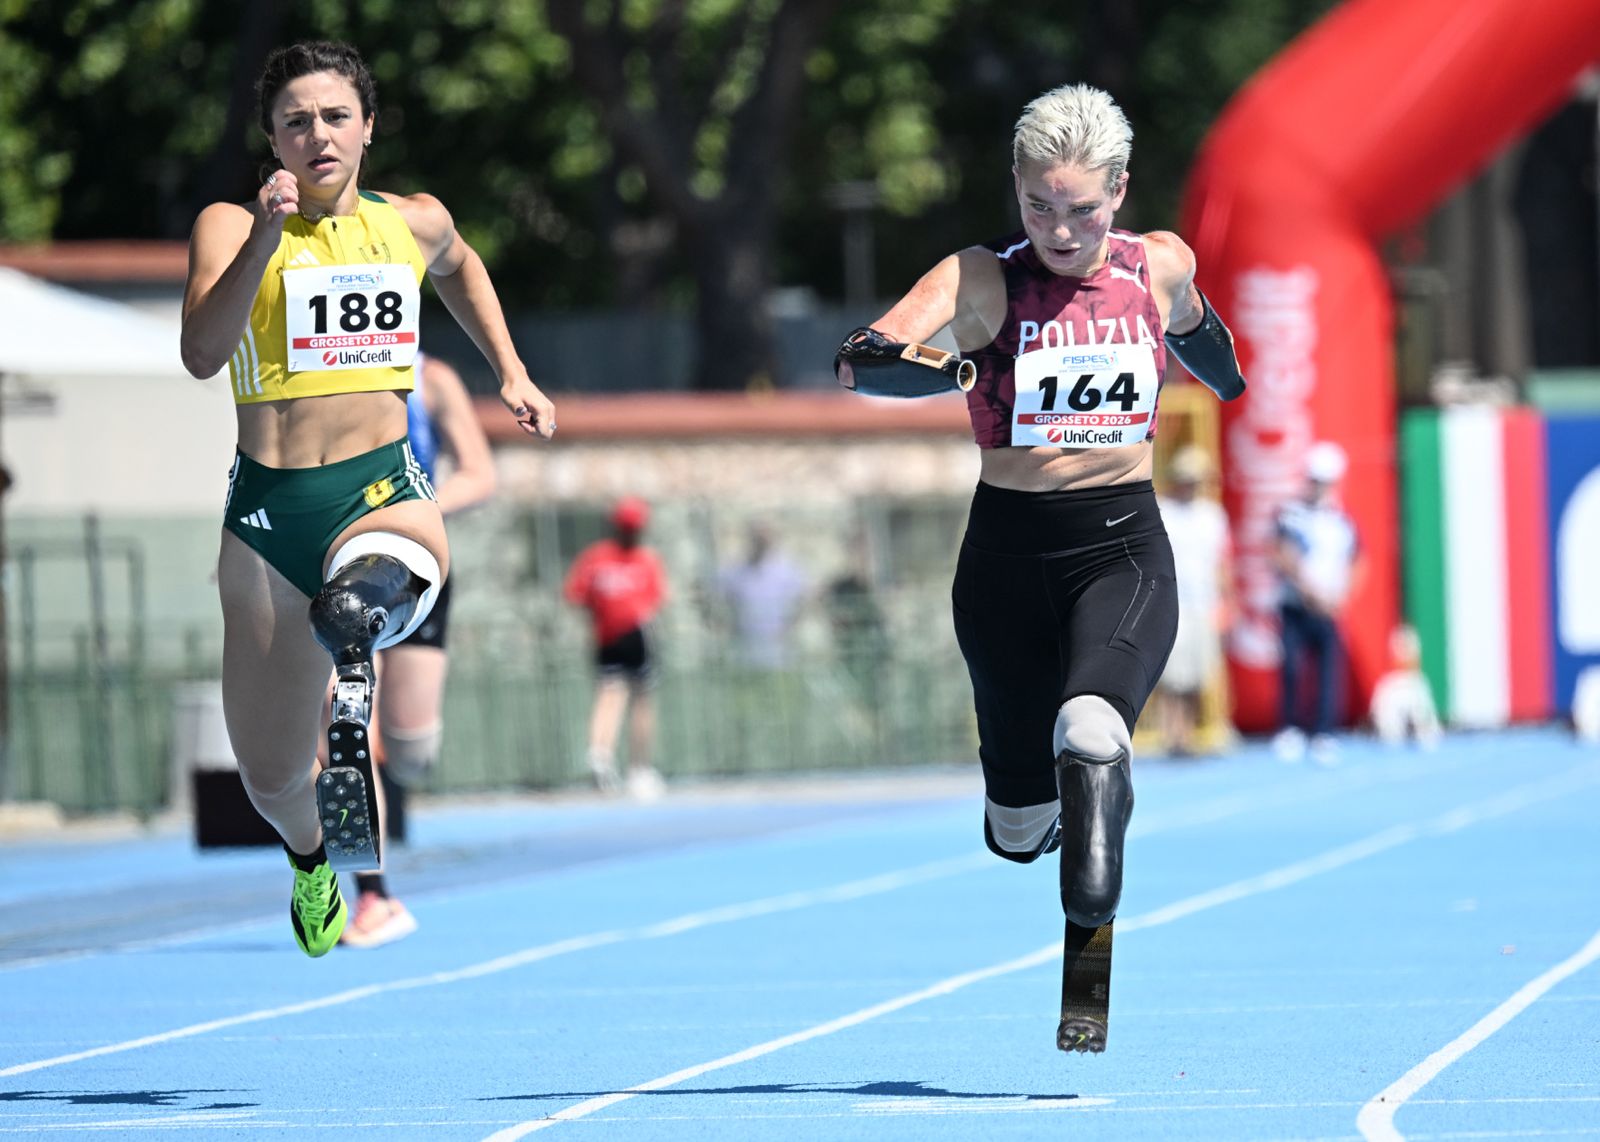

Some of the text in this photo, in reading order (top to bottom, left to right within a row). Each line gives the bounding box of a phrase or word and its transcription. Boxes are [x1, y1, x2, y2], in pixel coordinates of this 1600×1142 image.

[331, 274, 376, 284] FISPES
[309, 291, 403, 334] 188
[309, 334, 398, 348] GROSSETO 2026
[339, 349, 392, 364] UniCredit
[1062, 354, 1109, 365] FISPES
[1039, 372, 1139, 411] 164
[1034, 415, 1131, 425] GROSSETO 2026
[1064, 429, 1122, 444] UniCredit
